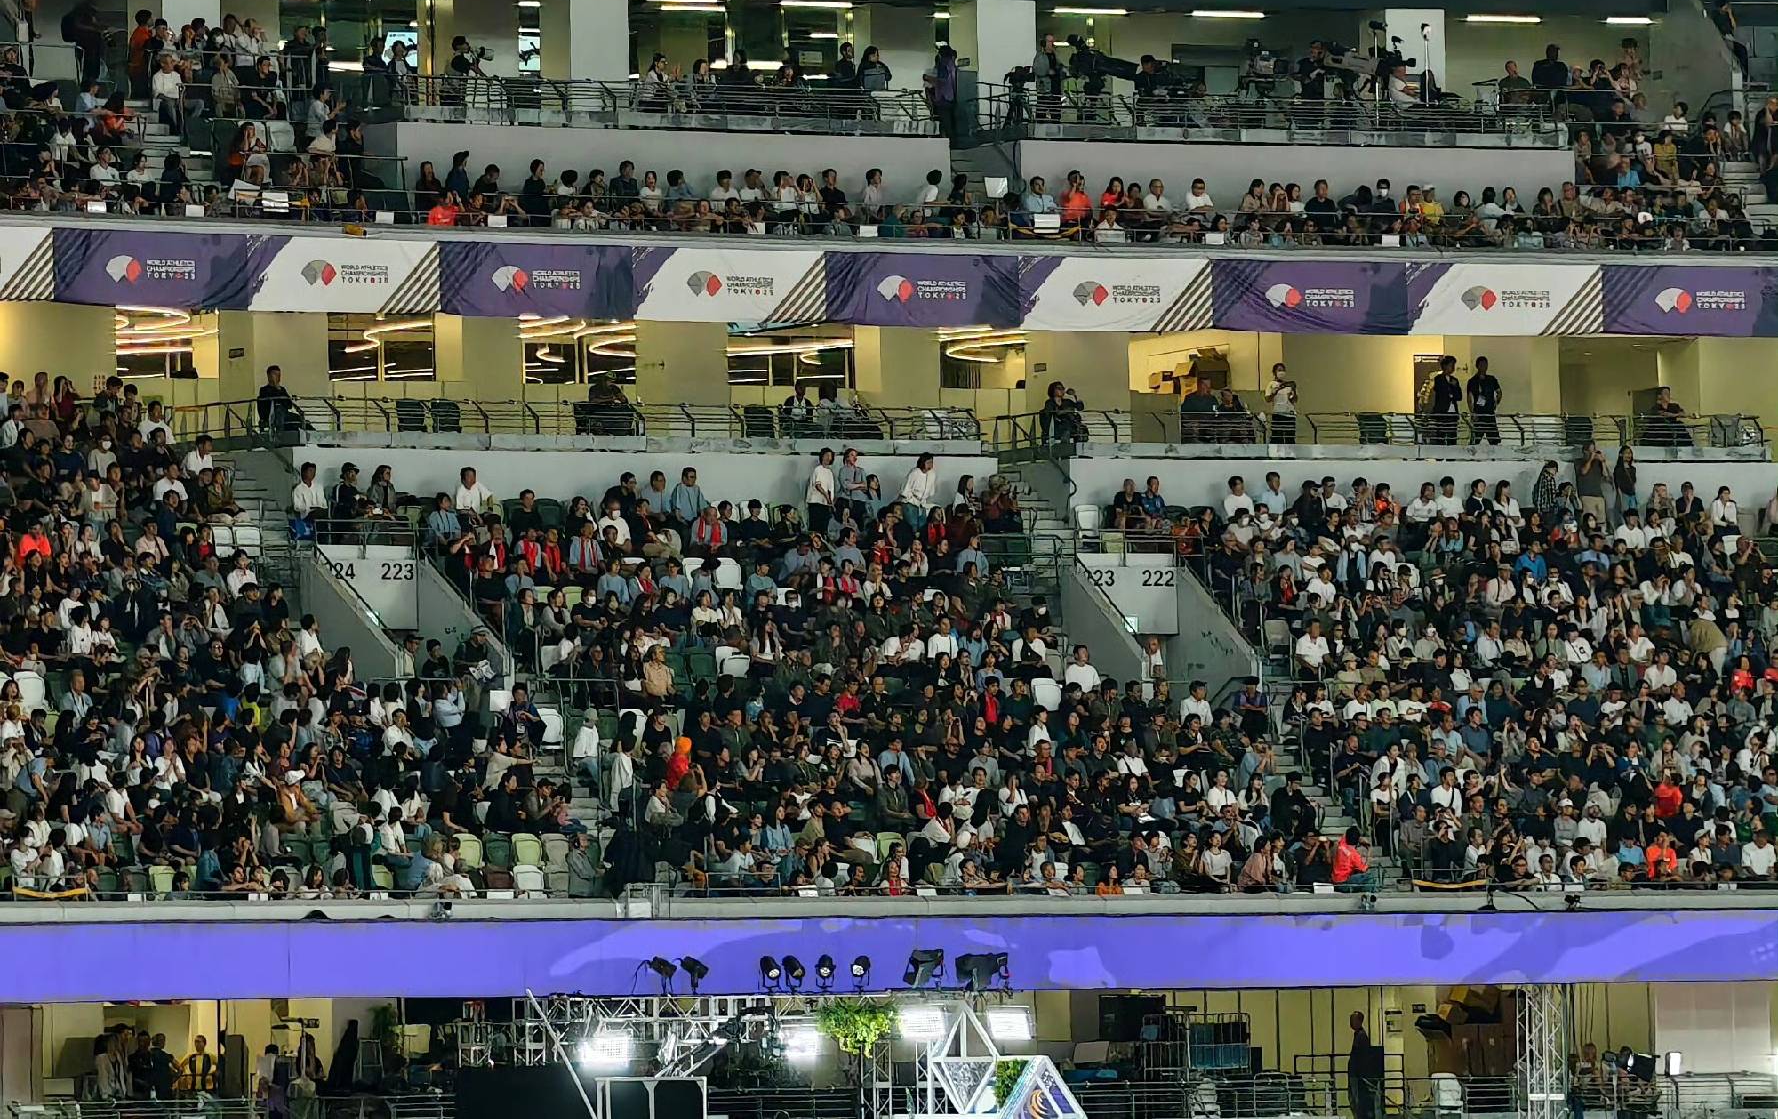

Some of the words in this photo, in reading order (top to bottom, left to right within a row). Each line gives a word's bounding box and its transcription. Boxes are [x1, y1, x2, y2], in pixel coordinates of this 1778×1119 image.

[381, 563, 414, 580] 223
[1087, 570, 1115, 586] 23
[1142, 570, 1174, 587] 222
